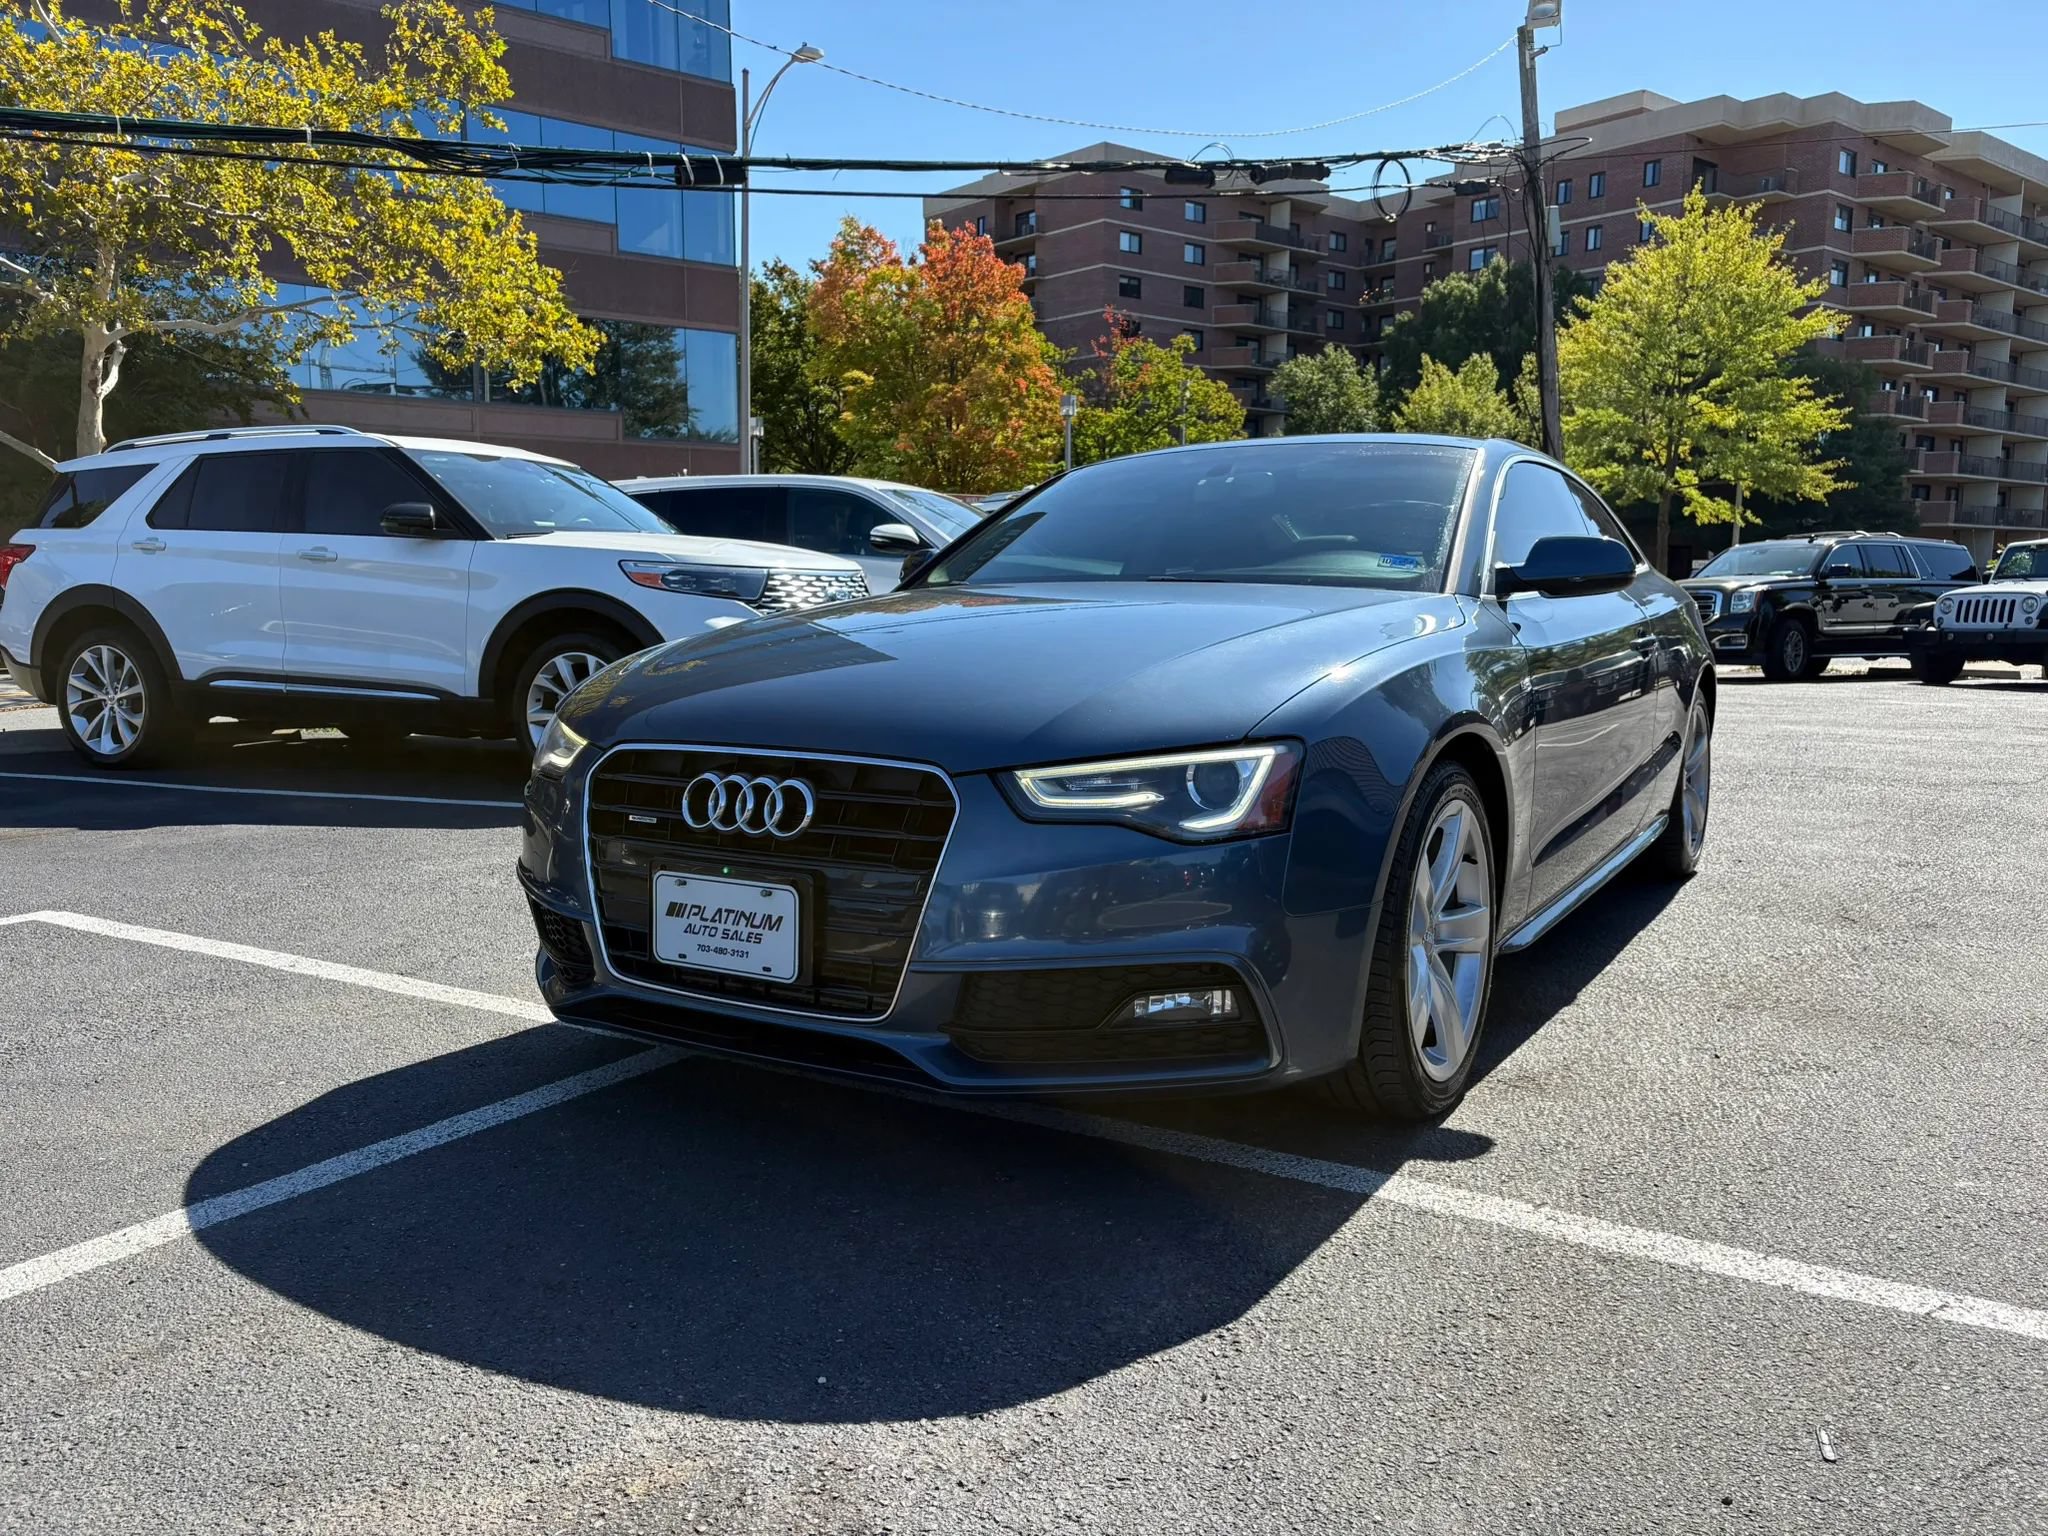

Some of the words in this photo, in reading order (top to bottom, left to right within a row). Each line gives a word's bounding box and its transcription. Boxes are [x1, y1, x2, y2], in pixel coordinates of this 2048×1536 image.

[686, 904, 783, 932] PLATINUM
[684, 923, 718, 937] AUTO
[721, 929, 763, 944] SALES
